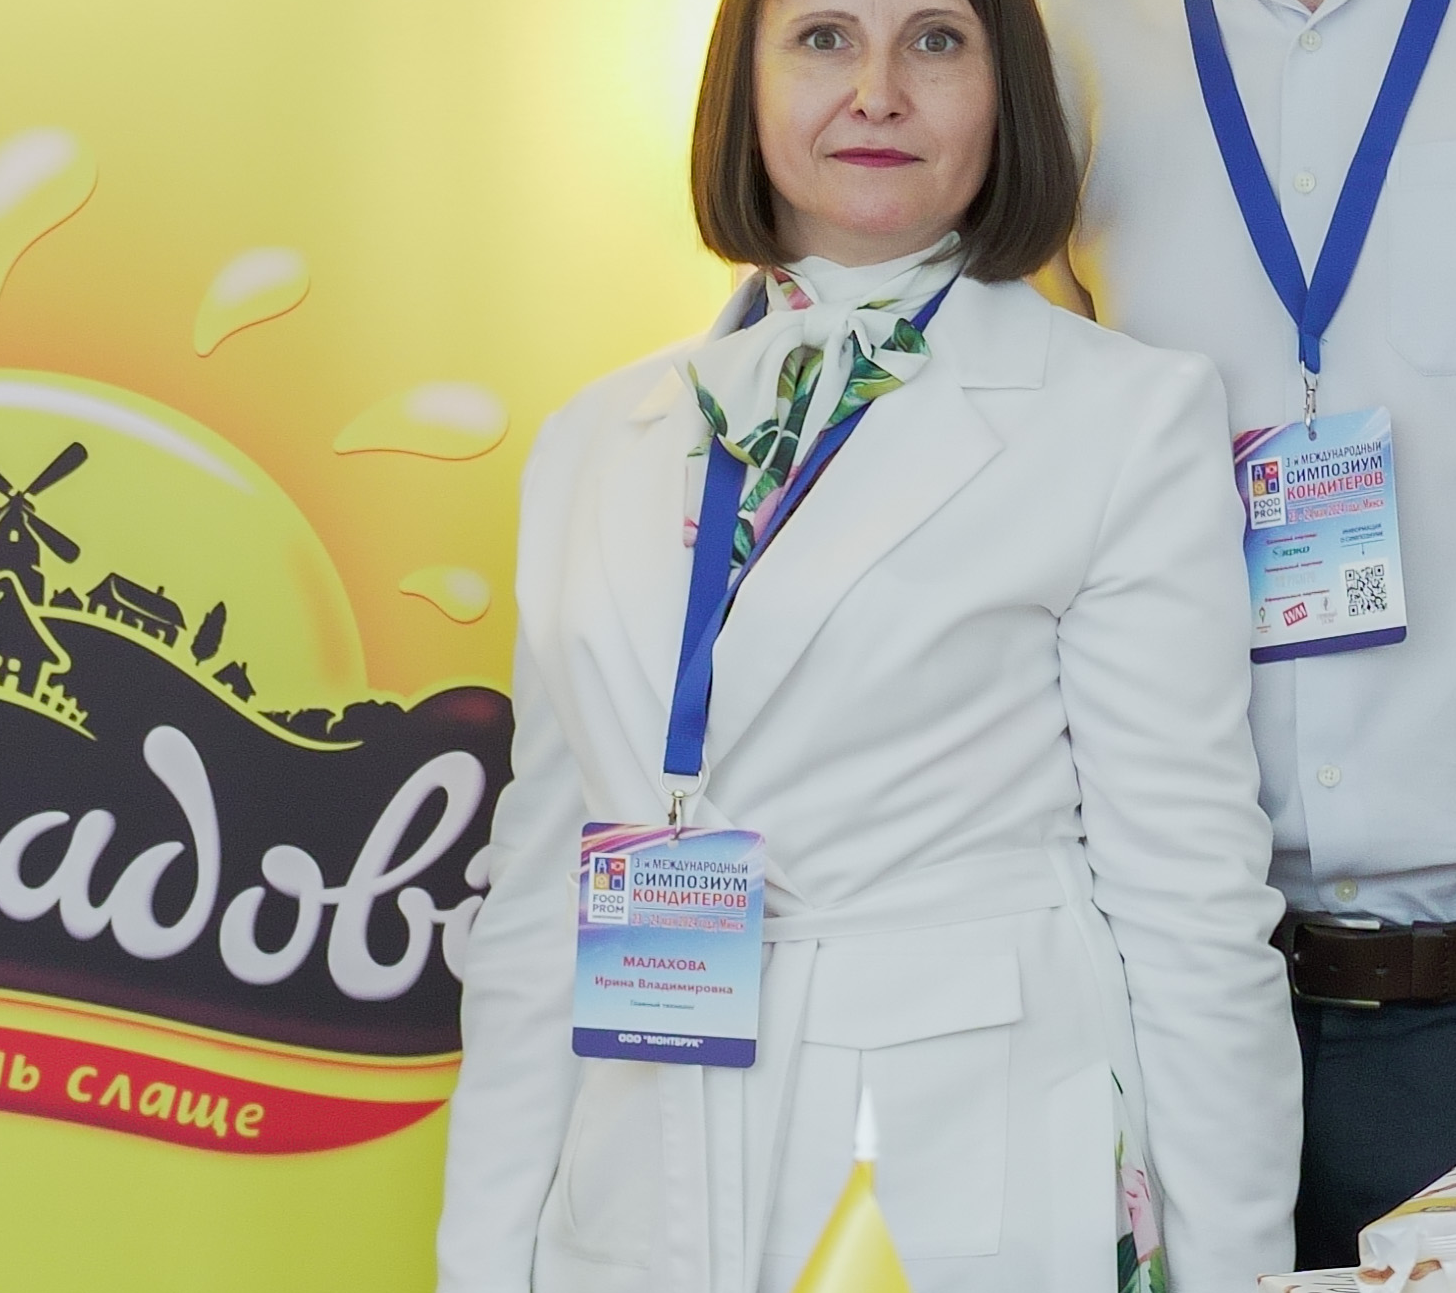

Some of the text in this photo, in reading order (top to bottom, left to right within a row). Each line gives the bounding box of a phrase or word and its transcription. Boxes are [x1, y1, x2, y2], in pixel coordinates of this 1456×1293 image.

[1301, 441, 1382, 465] МЕЖДУНАРОДНЫЙ
[1287, 456, 1382, 484] СИМПОЗИУМ
[1287, 472, 1384, 500] КОНДИТЕРОВ
[1254, 498, 1281, 508] FOOD
[1254, 508, 1281, 519] PROM
[653, 859, 748, 874] МЕЖДУНАРОДНЫЙ
[634, 872, 748, 892] СИМПОЗИУМ
[593, 894, 624, 903] FOOD
[633, 889, 747, 908] КОНДИТЕРОВ
[593, 904, 624, 914] PROM
[623, 956, 706, 971] МАЛАХОВА
[595, 977, 733, 995] Ирина Владимировна
[618, 1033, 641, 1044] ООО
[65, 1063, 267, 1140] слаще
